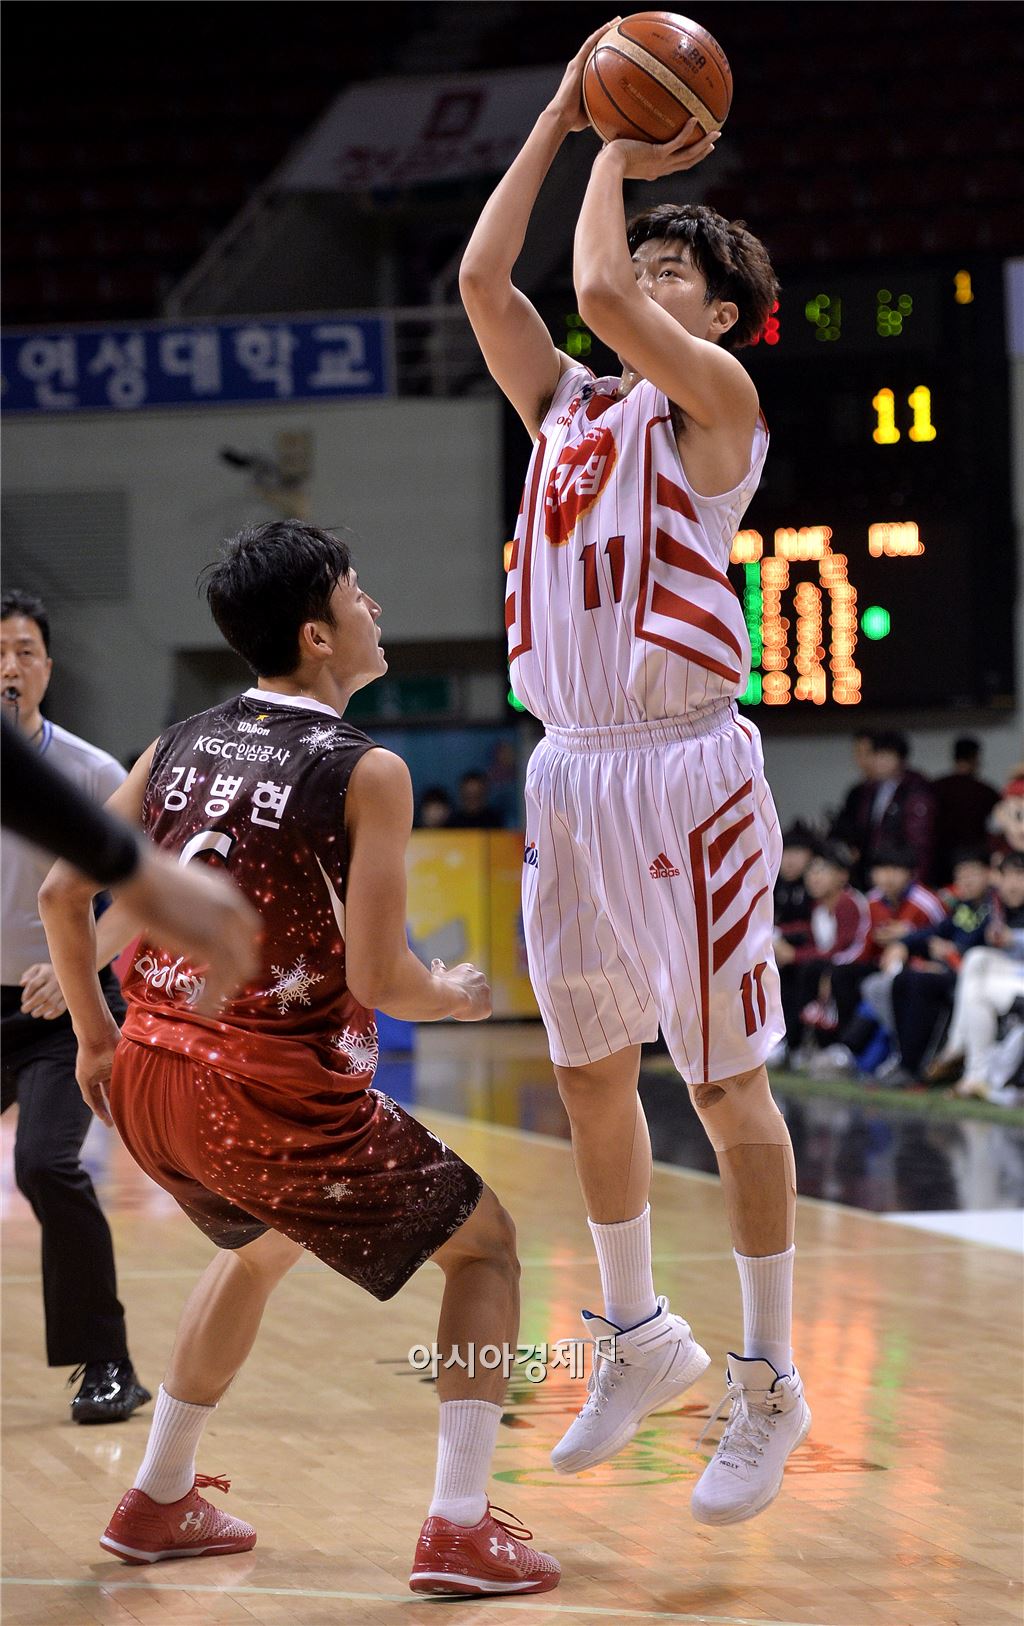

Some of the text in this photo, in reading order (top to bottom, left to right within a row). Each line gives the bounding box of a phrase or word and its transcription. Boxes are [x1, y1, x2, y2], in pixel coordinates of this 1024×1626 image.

[17, 323, 374, 408] 연성대학교
[872, 385, 937, 444] 11
[578, 535, 626, 611] 11
[237, 721, 271, 736] Wilson
[649, 868, 680, 879] adidas
[739, 961, 768, 1037] 11
